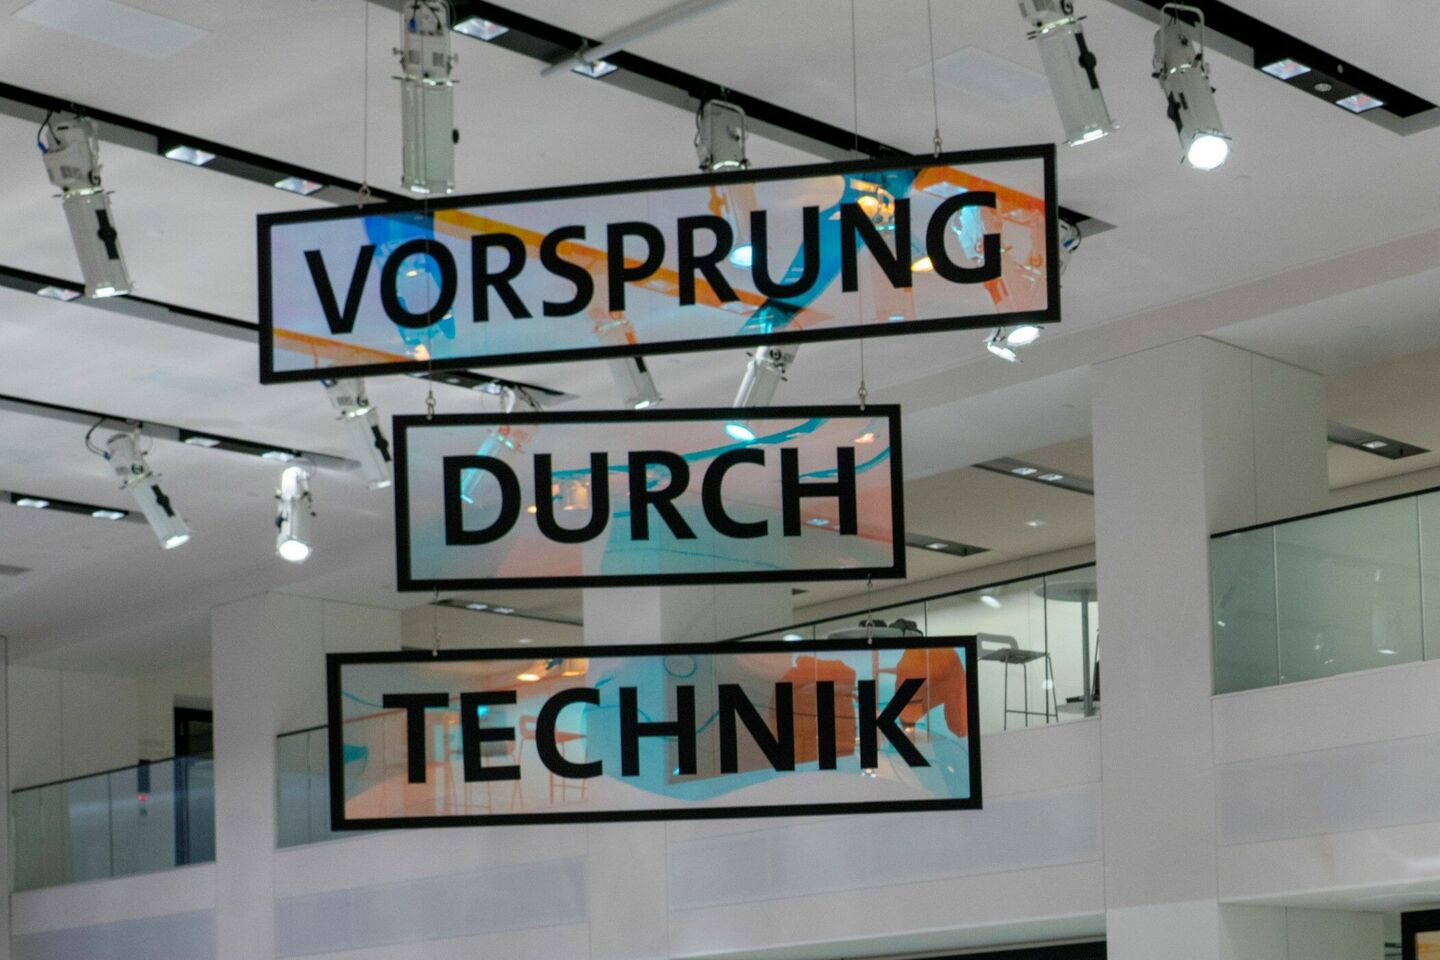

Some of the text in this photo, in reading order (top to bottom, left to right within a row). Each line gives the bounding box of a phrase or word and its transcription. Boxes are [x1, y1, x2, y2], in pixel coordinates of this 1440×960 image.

[304, 190, 1002, 335] VORSPRUNG
[442, 446, 859, 547] DURCH
[383, 677, 931, 785] TECHNIK
